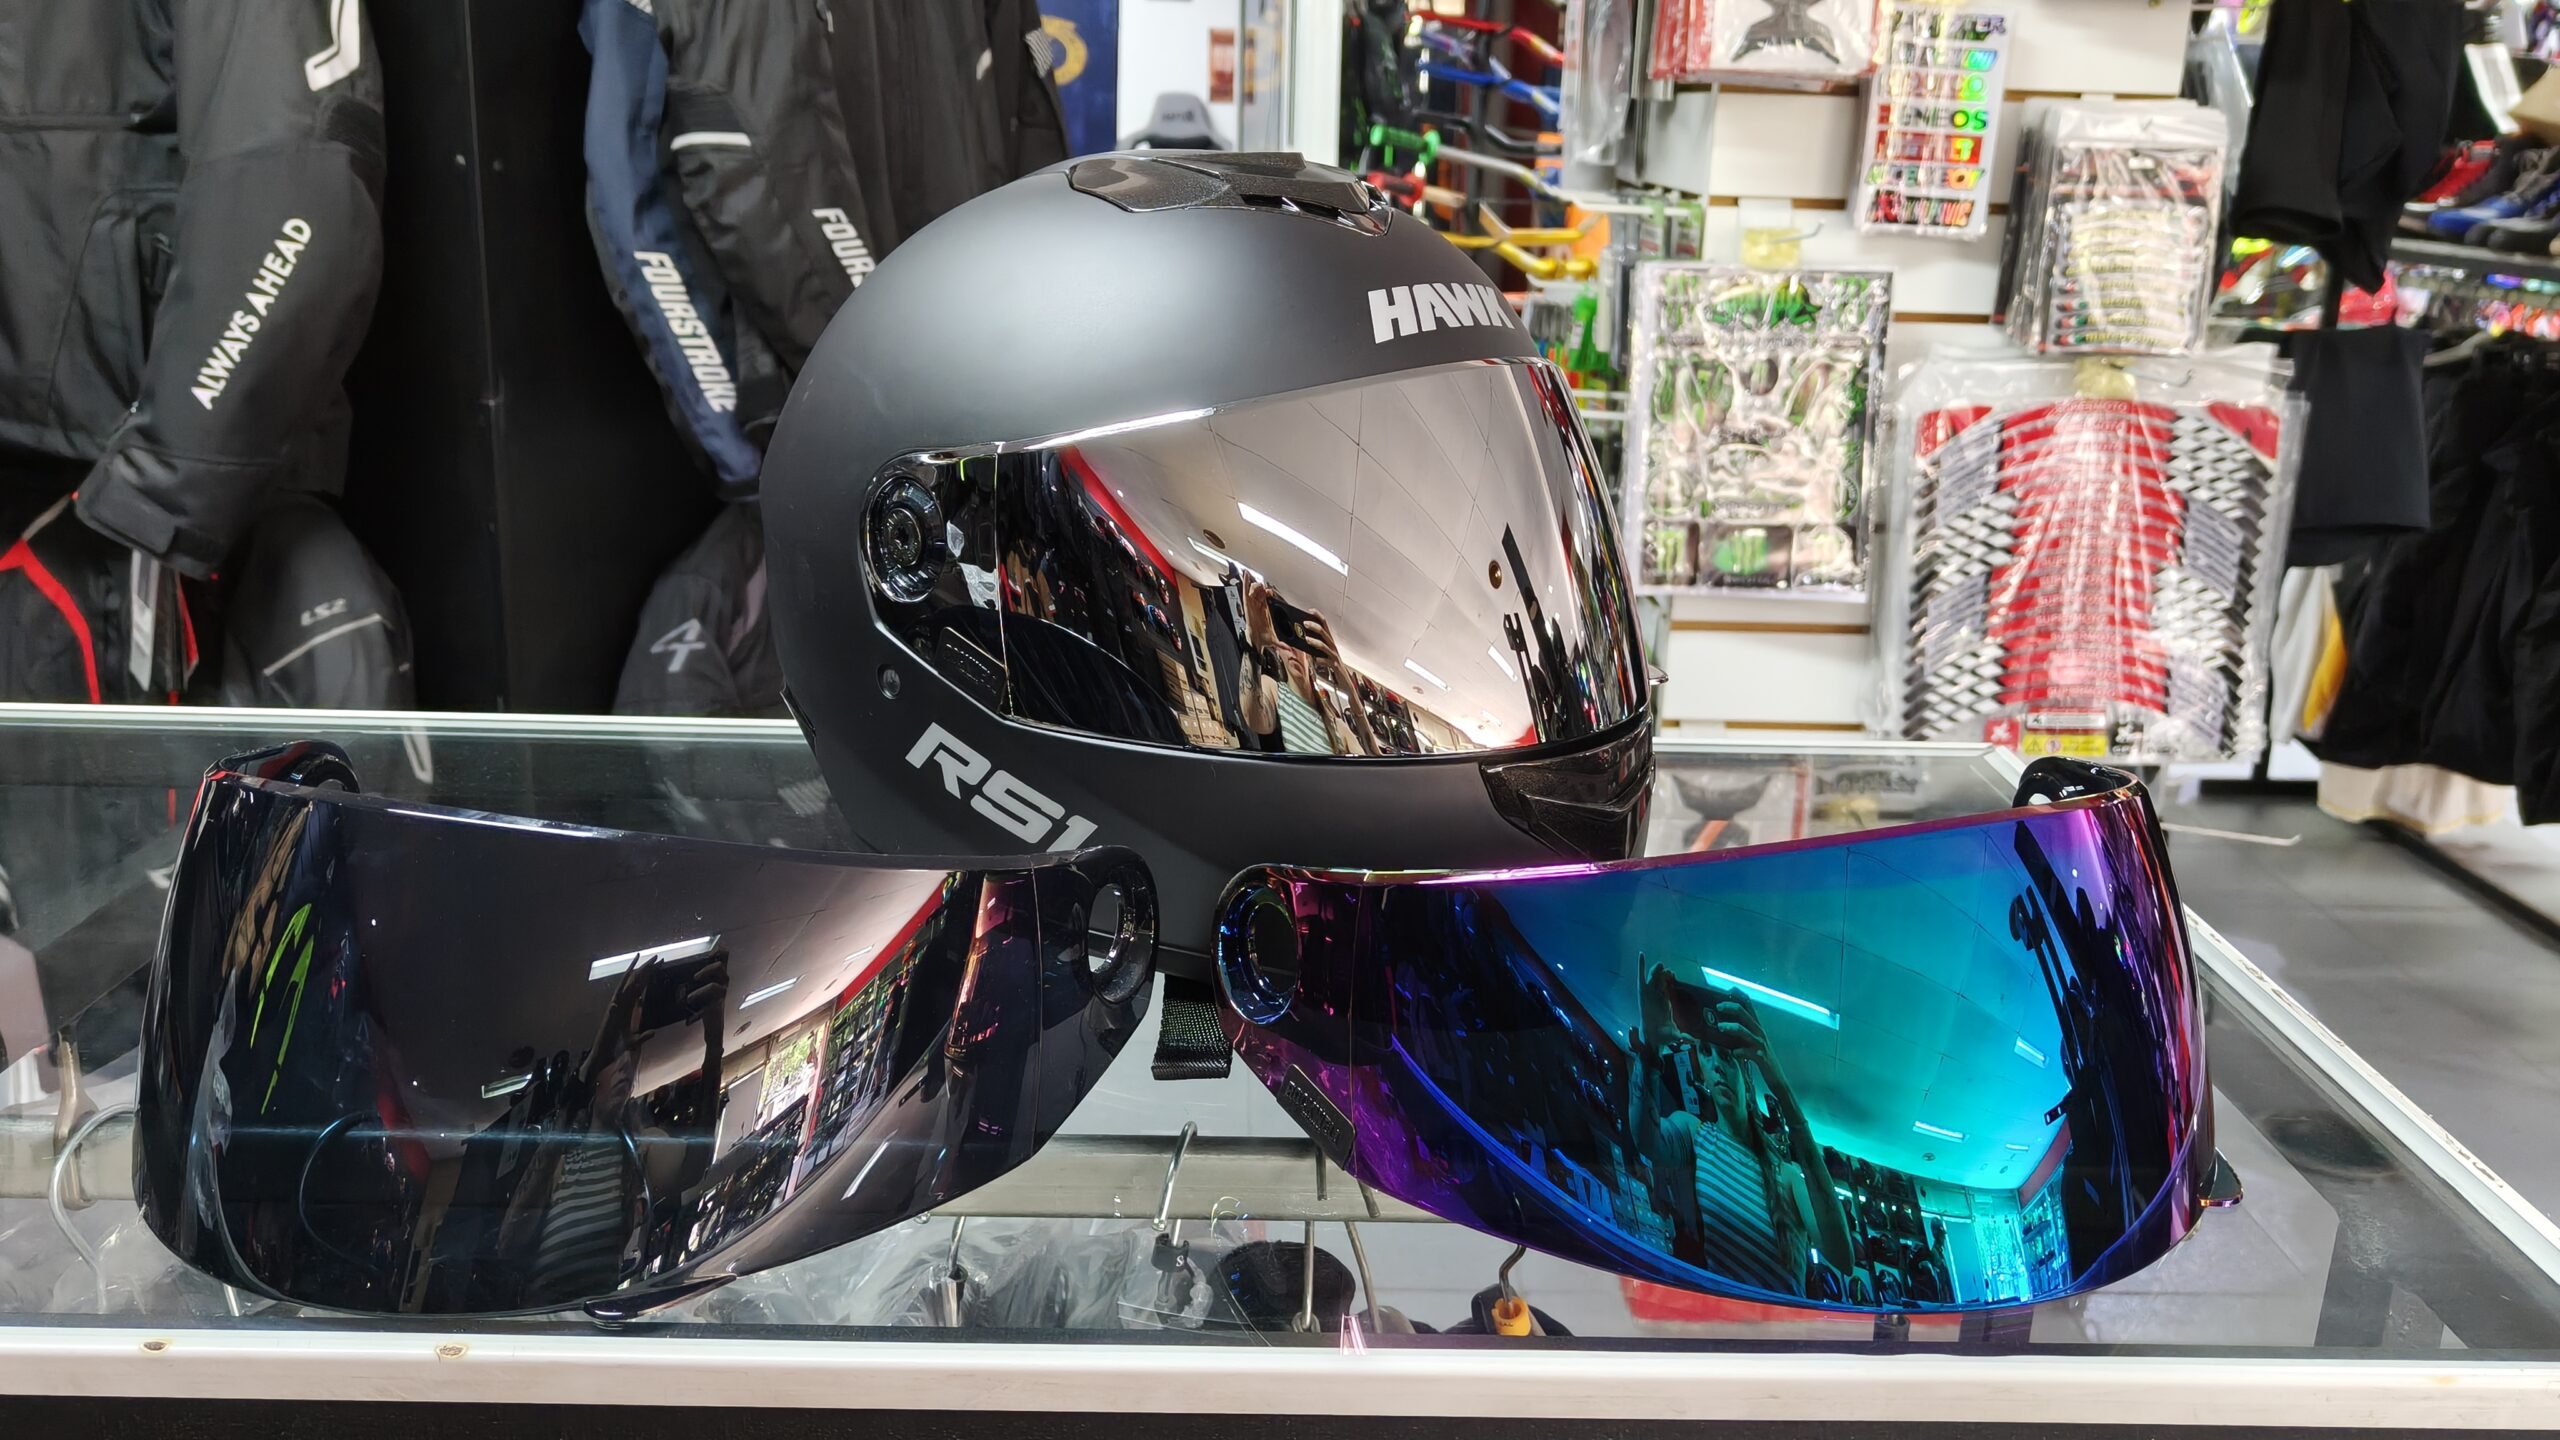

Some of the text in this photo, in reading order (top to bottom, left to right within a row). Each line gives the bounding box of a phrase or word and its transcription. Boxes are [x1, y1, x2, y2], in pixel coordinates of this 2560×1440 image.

[191, 218, 312, 411] ALWAYS AHEAD
[633, 250, 737, 413] FOURSTROKE
[1367, 282, 1516, 344] HAWK
[300, 598, 348, 627] LS2
[650, 618, 706, 674] 4
[905, 721, 1099, 853] RS1
